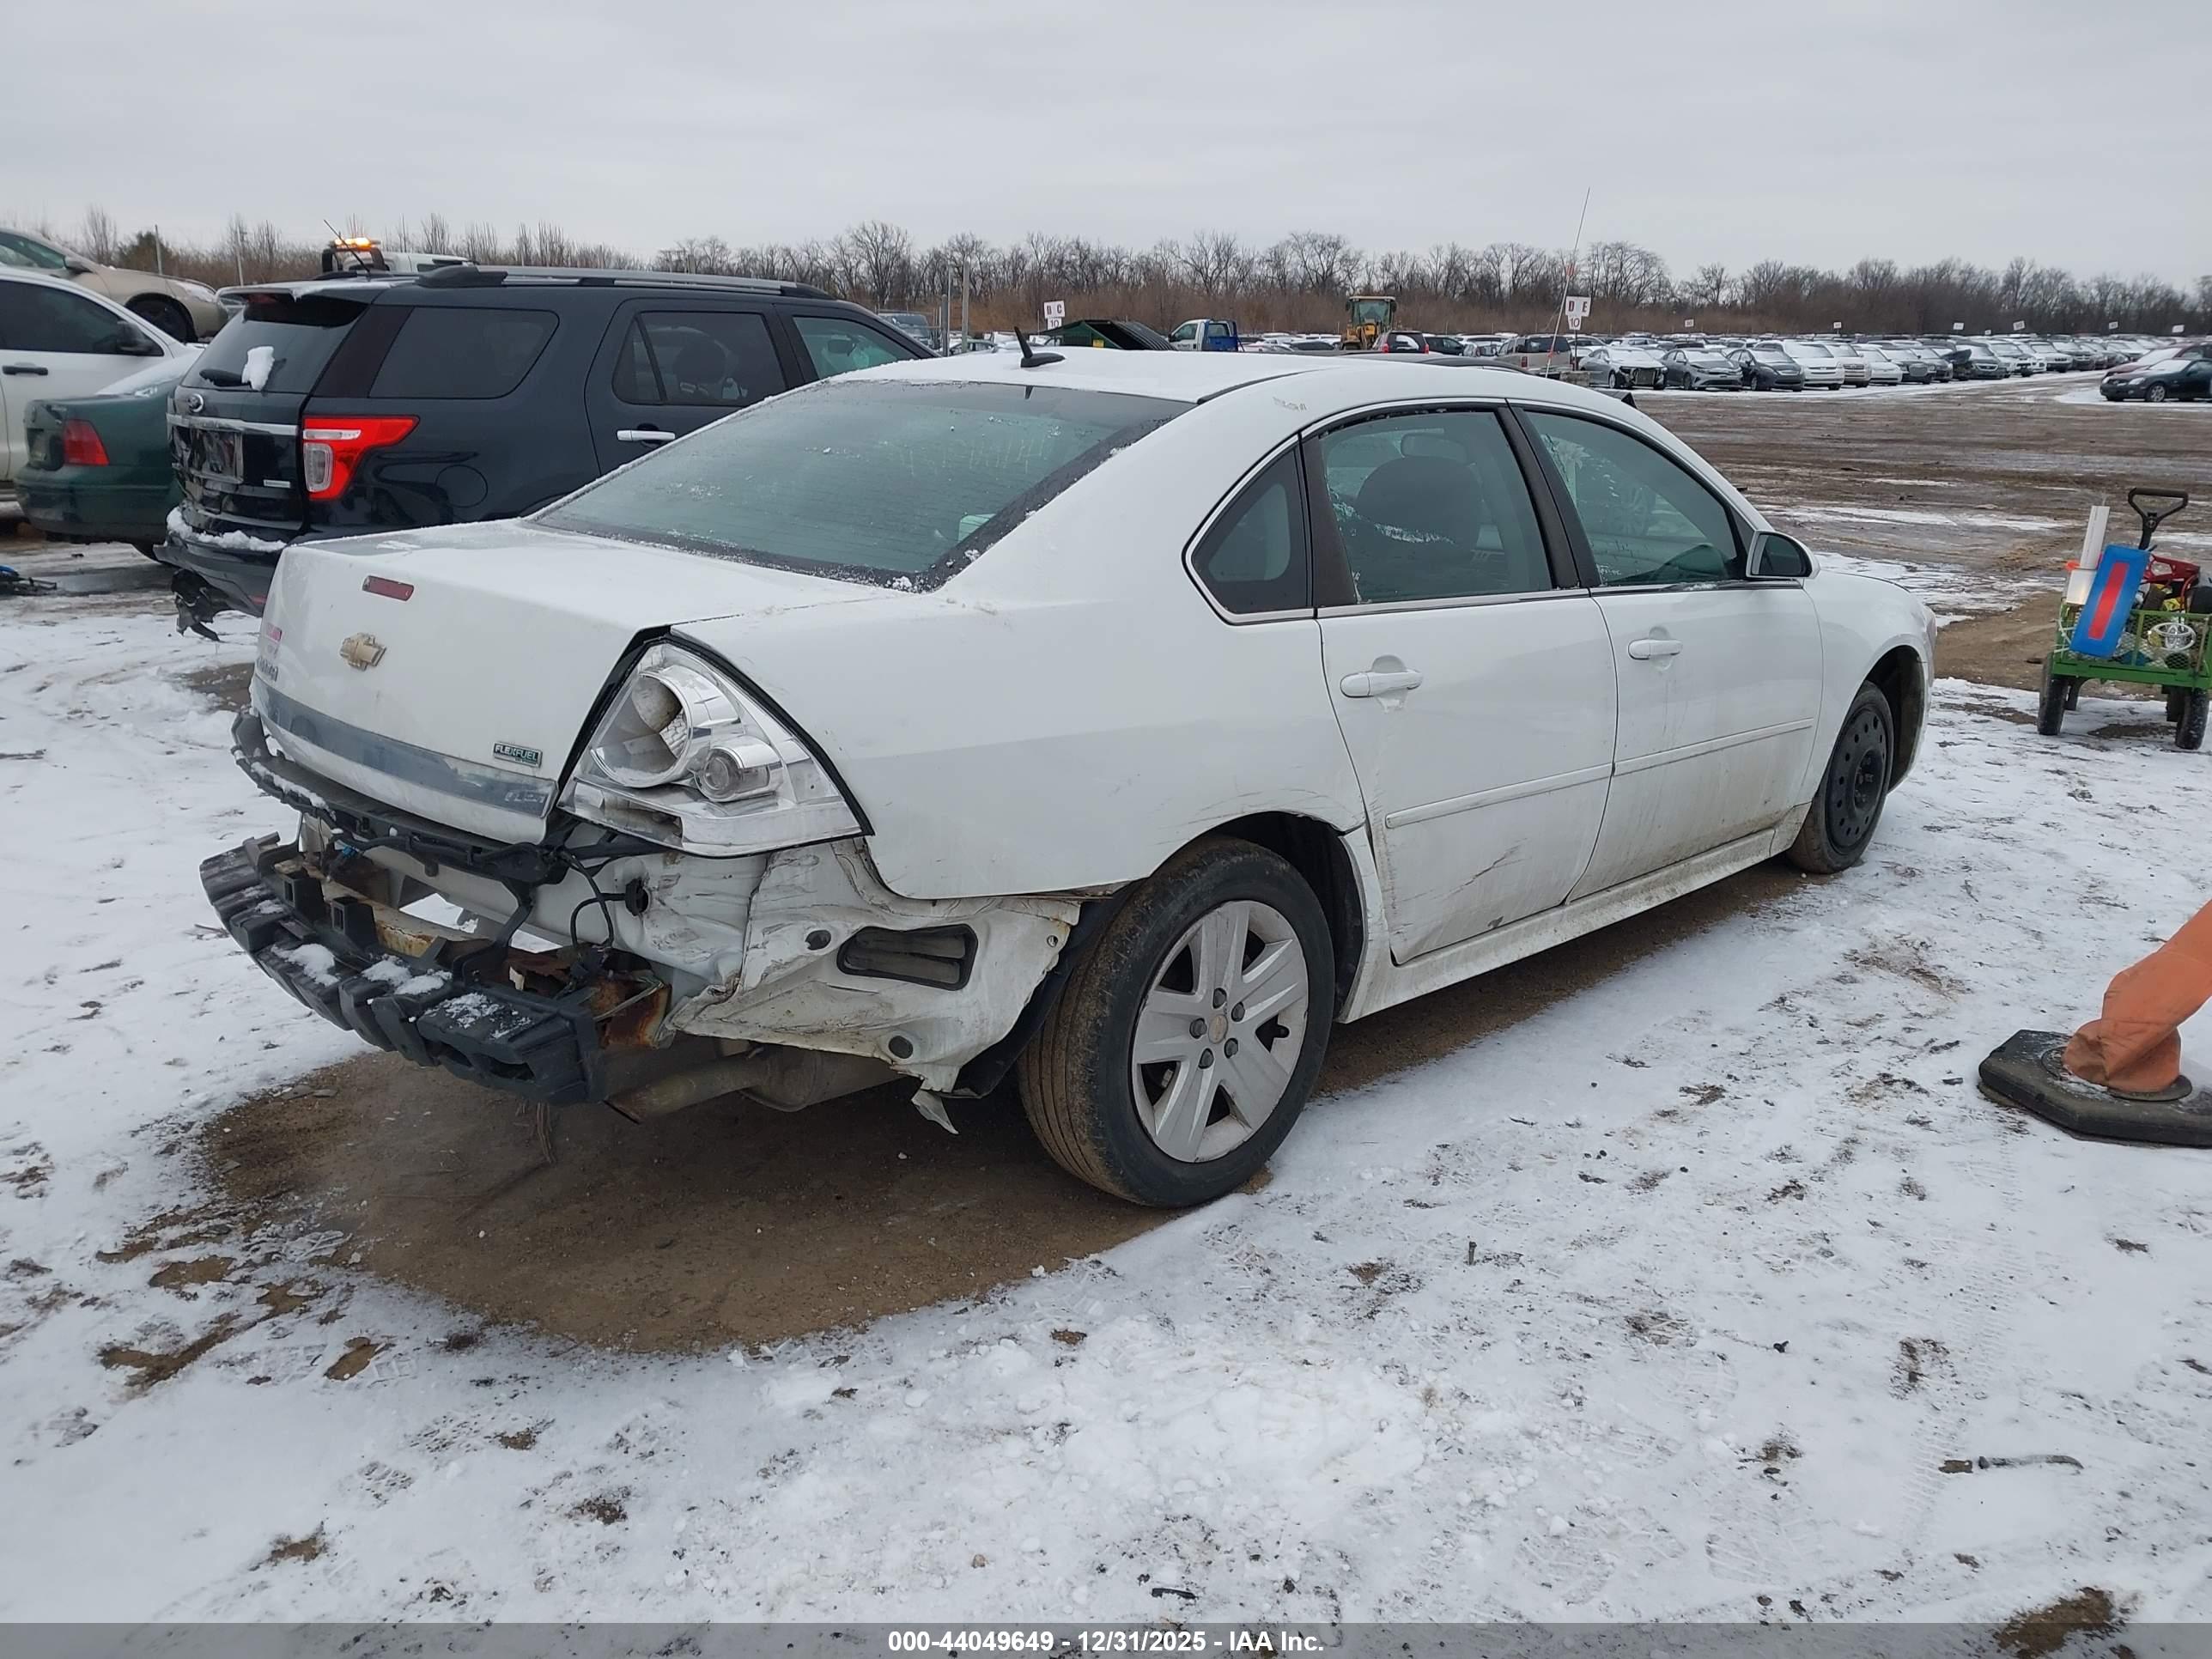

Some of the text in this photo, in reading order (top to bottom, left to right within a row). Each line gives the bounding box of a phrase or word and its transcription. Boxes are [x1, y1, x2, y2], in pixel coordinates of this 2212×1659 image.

[1582, 301, 1588, 313] E
[1570, 318, 1580, 327] 10
[495, 744, 537, 761] FLEXFUEL
